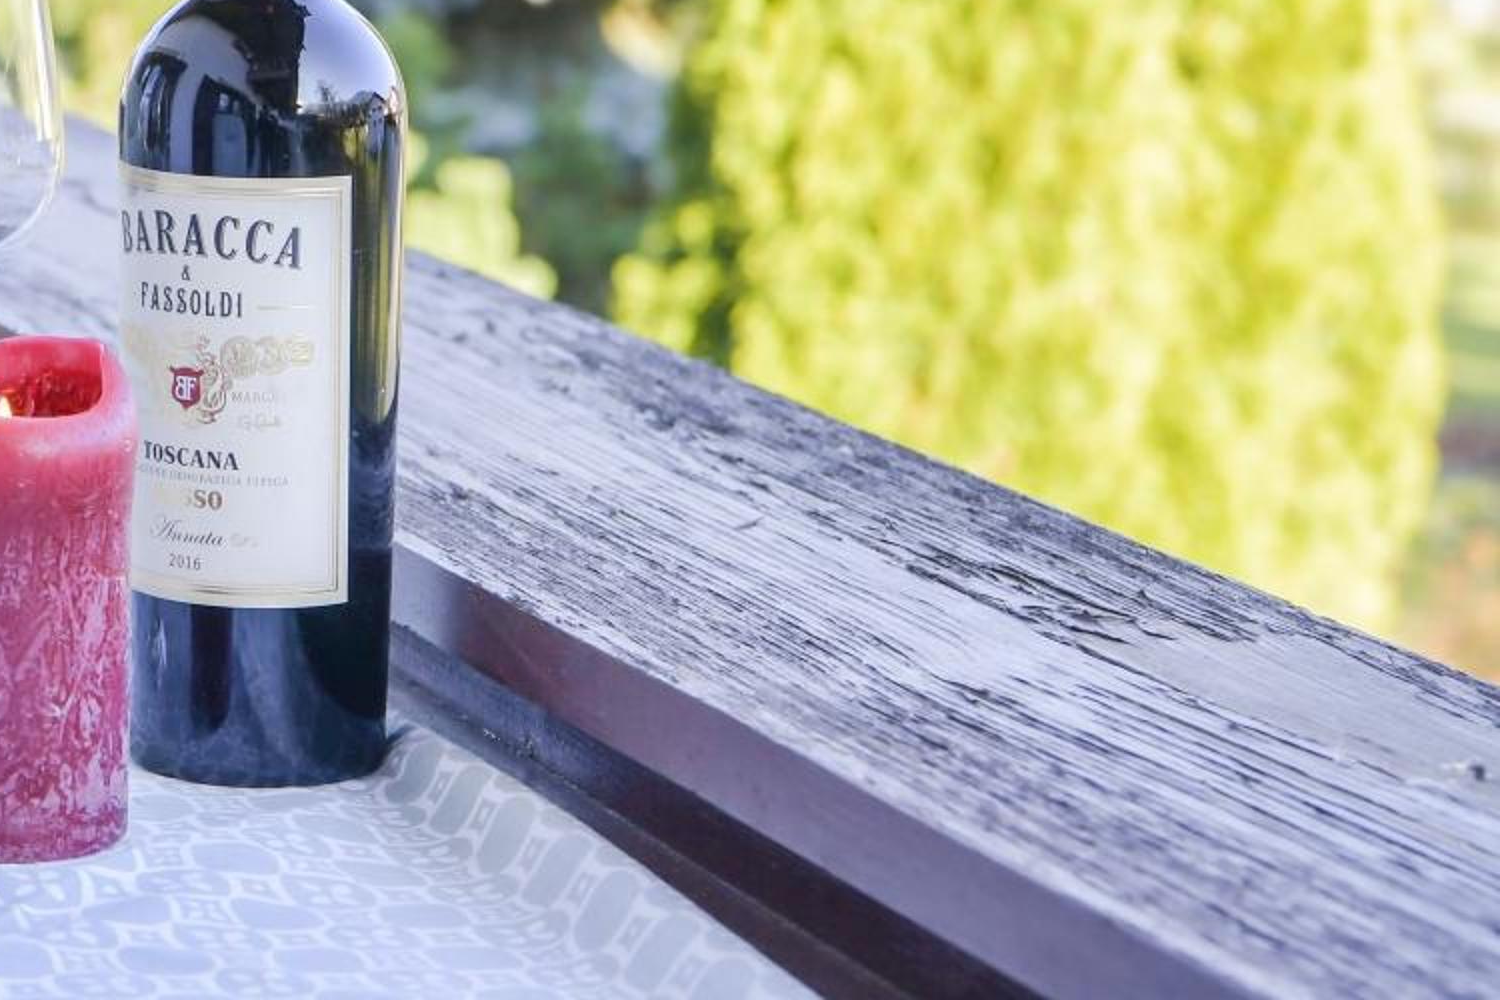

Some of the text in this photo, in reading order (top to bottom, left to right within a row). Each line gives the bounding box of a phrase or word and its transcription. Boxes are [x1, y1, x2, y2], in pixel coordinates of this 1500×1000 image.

[121, 208, 302, 270] BARACCA
[181, 264, 192, 282] &
[140, 281, 243, 318] FASSOLDI
[143, 439, 240, 471] TOSCANA
[168, 552, 201, 571] 2016
